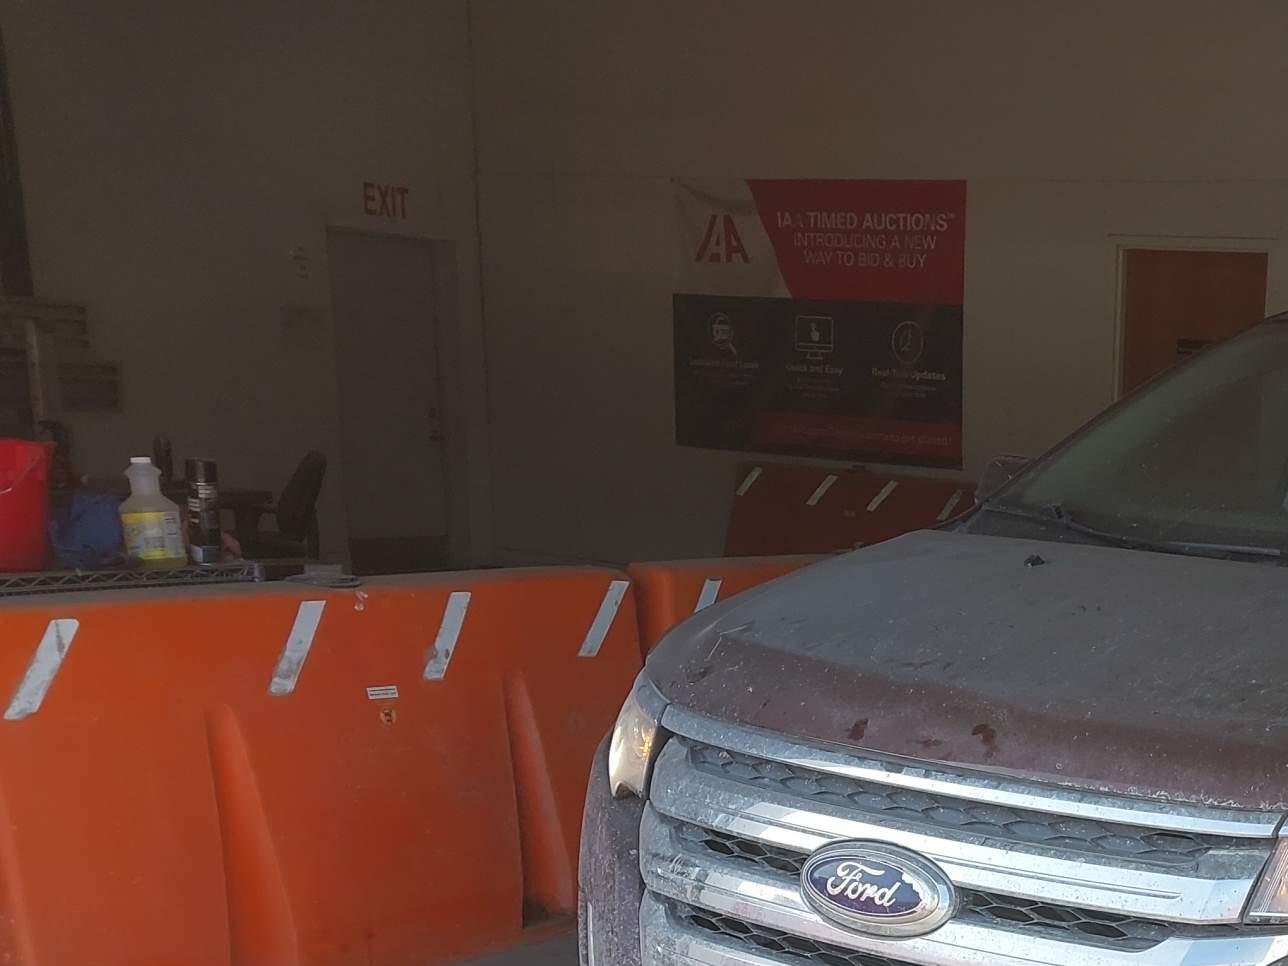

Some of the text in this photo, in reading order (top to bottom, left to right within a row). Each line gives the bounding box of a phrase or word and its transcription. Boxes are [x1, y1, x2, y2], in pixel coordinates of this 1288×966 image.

[363, 182, 408, 219] EXIT
[806, 212, 857, 229] TIMED
[793, 232, 937, 250] INTRODUCING A NEW
[803, 250, 928, 269] WAY TO BID & BUY
[826, 861, 902, 907] Ford
